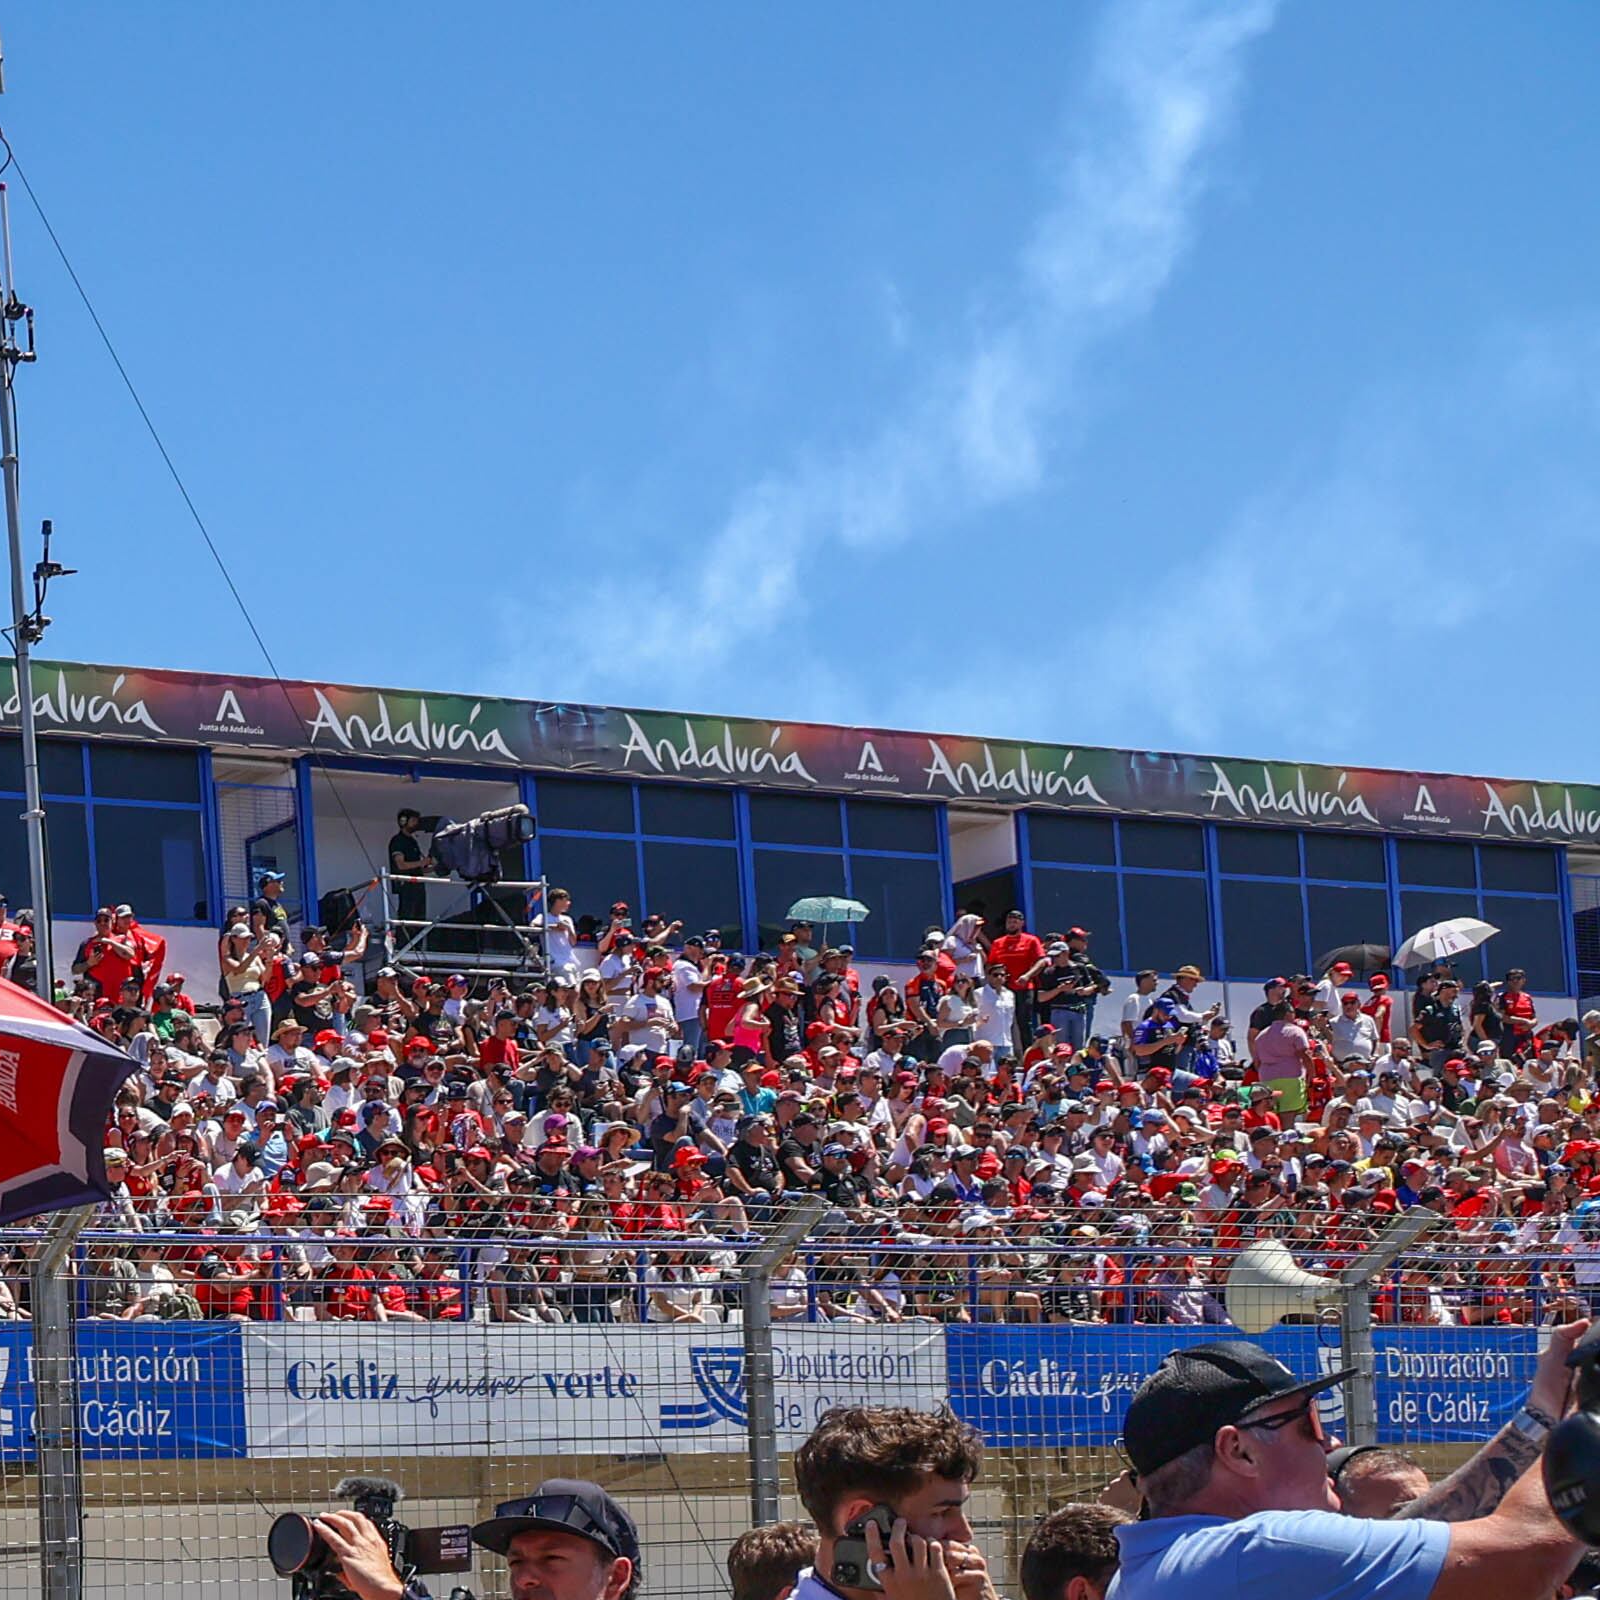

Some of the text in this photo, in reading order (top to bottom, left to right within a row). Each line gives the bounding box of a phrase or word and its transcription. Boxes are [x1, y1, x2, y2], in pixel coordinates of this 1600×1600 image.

[307, 688, 522, 760] Andalucía
[620, 714, 819, 781] Andalucía
[924, 740, 1109, 804] Andalucía
[1207, 762, 1380, 823] Andalucía
[1481, 783, 1600, 834] Andaluc
[27, 1346, 200, 1382] utación
[287, 1360, 400, 1401] Cádiz
[542, 1366, 638, 1399] verte
[771, 1346, 911, 1381] Diputación
[1385, 1346, 1510, 1381] Diputación
[982, 1358, 1150, 1413] Cádiz qui
[83, 1399, 172, 1437] Cádiz
[774, 1397, 802, 1429] de
[1388, 1391, 1490, 1423] de Cádiz
